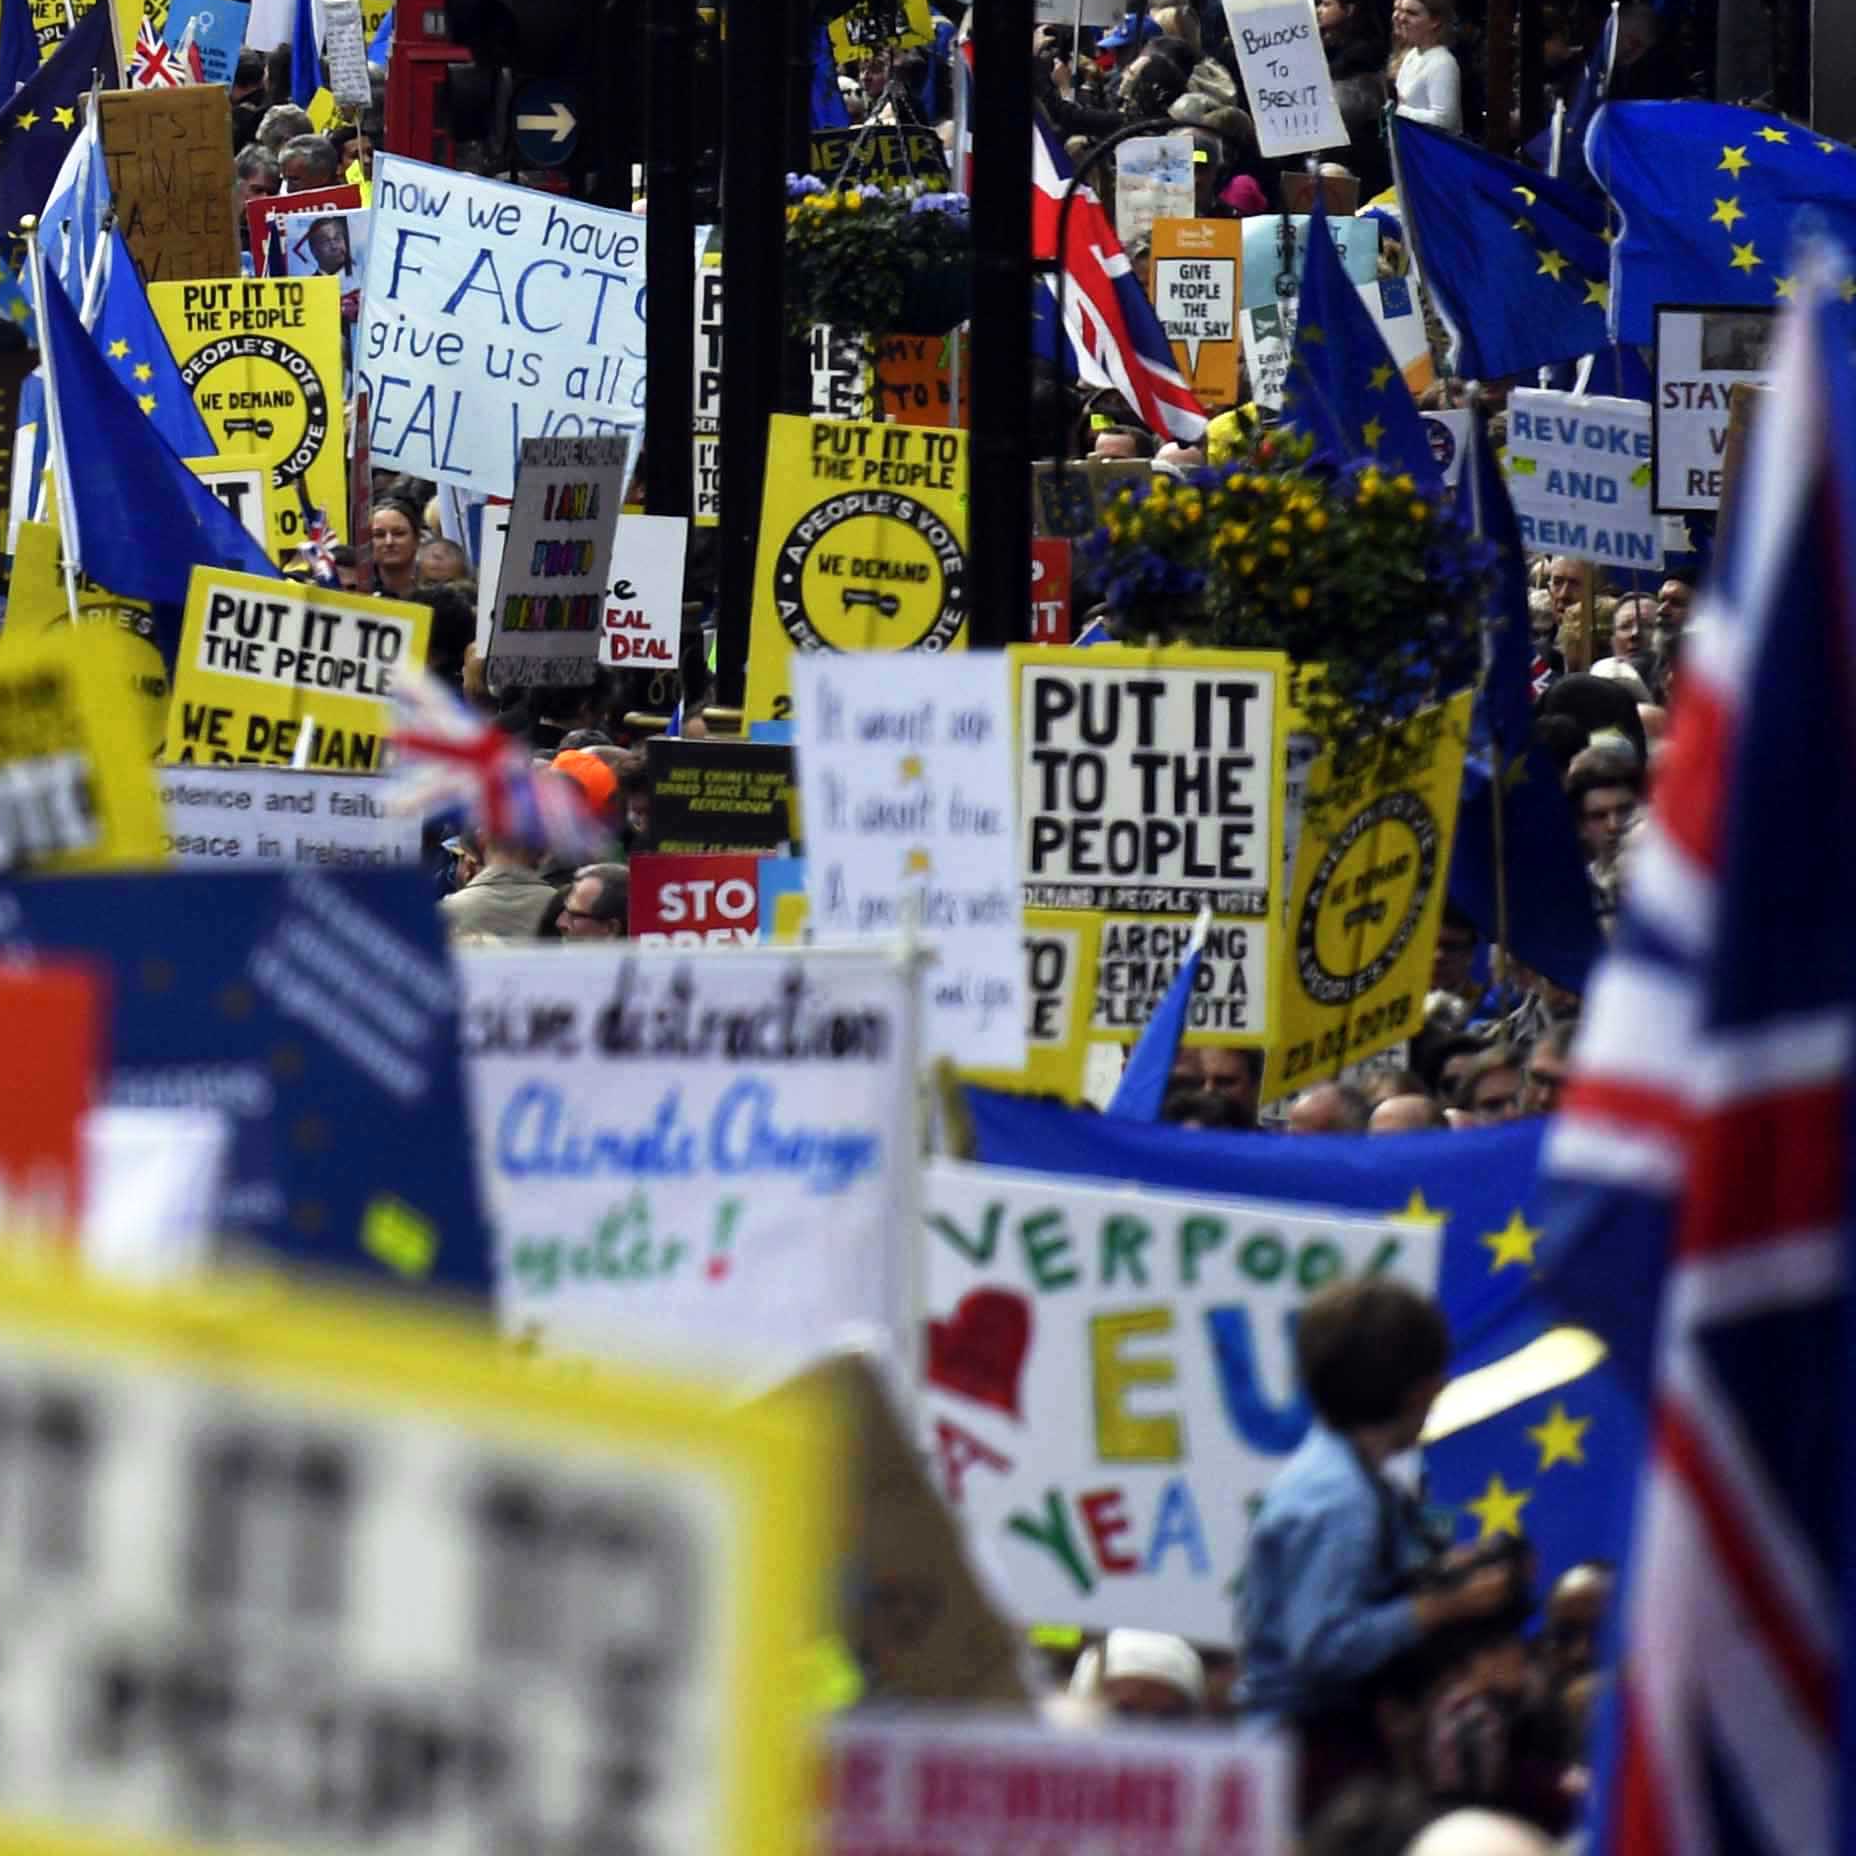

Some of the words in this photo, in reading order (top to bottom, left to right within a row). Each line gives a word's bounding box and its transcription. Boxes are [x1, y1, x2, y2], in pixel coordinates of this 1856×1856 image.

[1257, 85, 1318, 112] BREXIT
[380, 180, 450, 222] now
[467, 194, 522, 235] we
[540, 210, 639, 268] have
[1168, 282, 1222, 301] PEOPLE
[1178, 263, 1212, 283] GIVE
[183, 283, 235, 313] PUT
[242, 283, 268, 311] IT
[275, 283, 304, 308] TO
[184, 310, 223, 331] THE
[229, 305, 306, 330] PEOPLE
[1181, 301, 1208, 319] THE
[1201, 318, 1231, 338] SAY
[367, 316, 464, 366] give
[486, 346, 542, 388] us
[566, 355, 624, 405] all
[201, 391, 226, 411] WE
[228, 387, 295, 410] DEMAND
[1546, 469, 1619, 506] AND
[1517, 515, 1656, 562] REMAIN
[207, 594, 286, 642] PUT
[302, 605, 339, 649] IT
[356, 618, 402, 663] TO
[610, 635, 672, 662] DEAL
[206, 635, 259, 673] THE
[272, 648, 394, 700] PEOPLE
[182, 702, 236, 742] WE
[1033, 677, 1161, 747] PUT
[1193, 682, 1259, 750] IT
[1031, 749, 1118, 815] TO
[1137, 755, 1255, 819] THE
[1029, 817, 1254, 880] PEOPLE
[658, 878, 755, 921] STO
[596, 962, 890, 1066] distraction
[1089, 1304, 1307, 1466] EU
